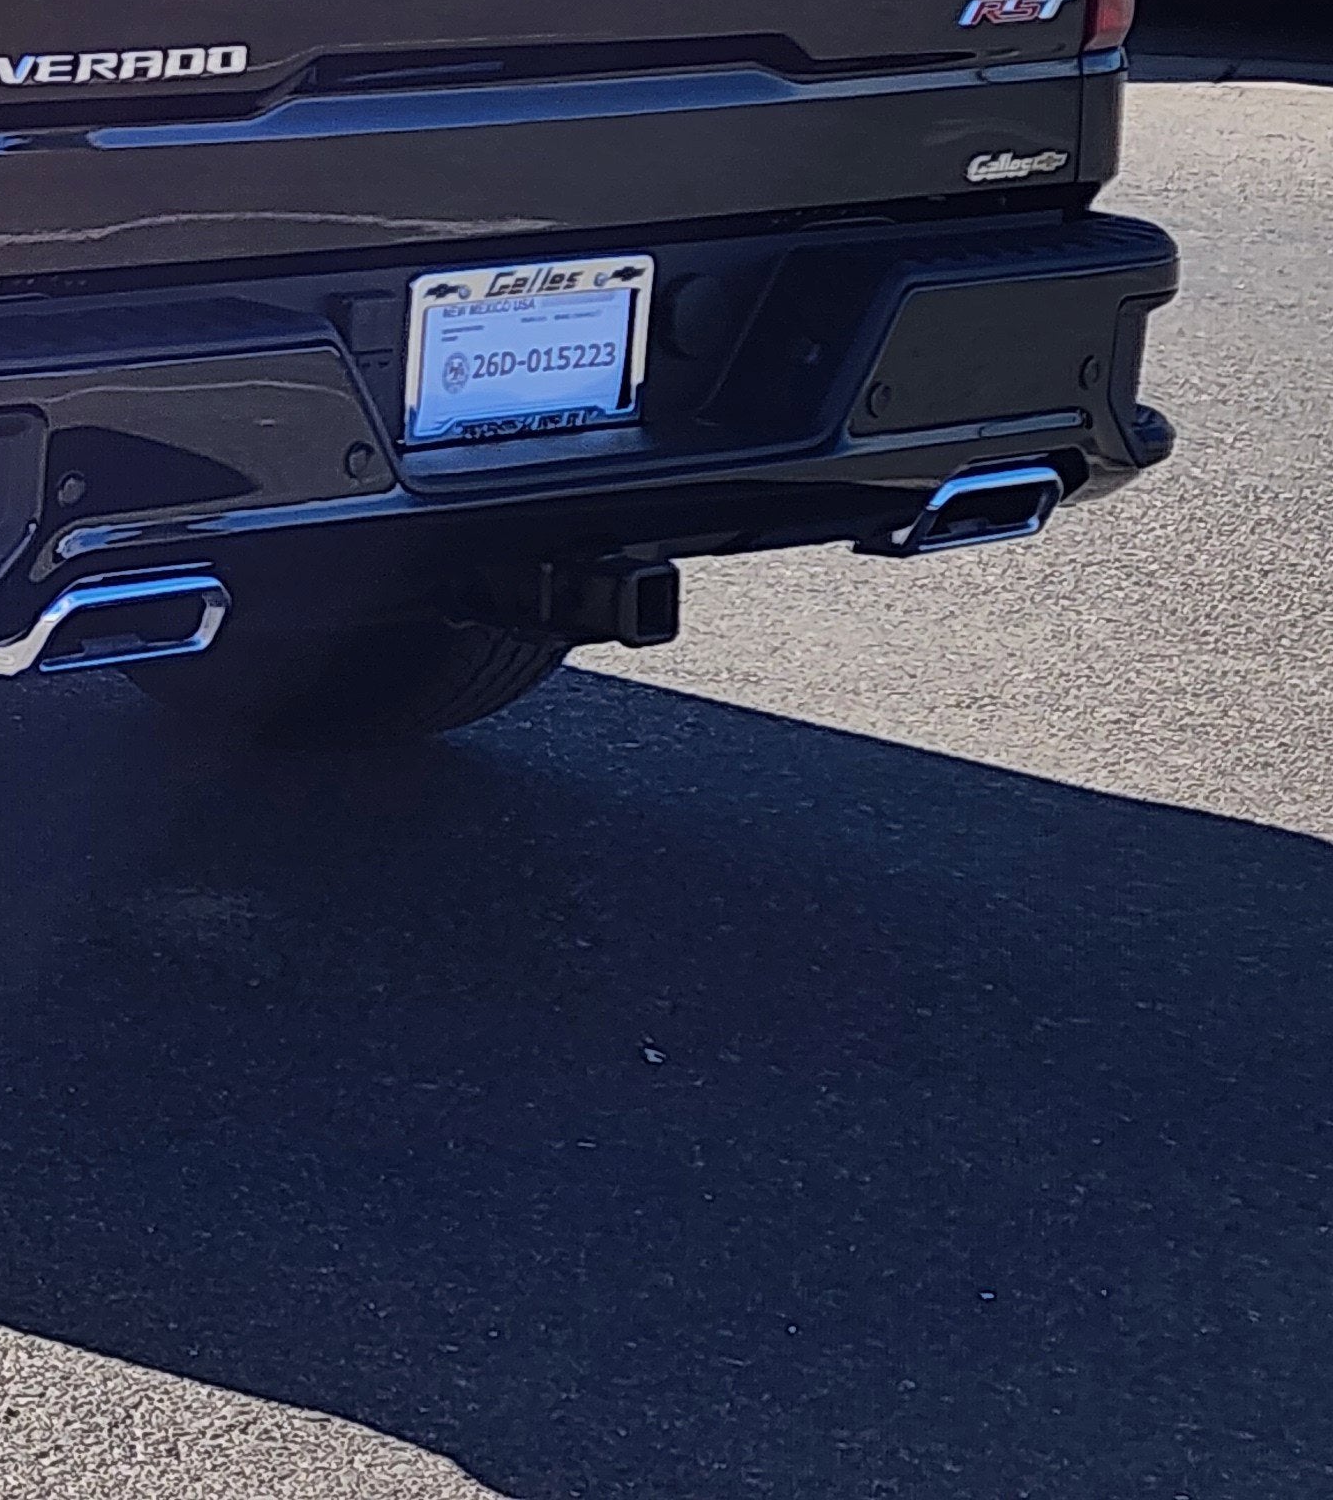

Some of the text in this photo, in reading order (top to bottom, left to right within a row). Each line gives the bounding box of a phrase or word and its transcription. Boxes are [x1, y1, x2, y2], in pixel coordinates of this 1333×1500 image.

[484, 266, 585, 298] Galles
[468, 301, 510, 316] MEXICO
[513, 298, 536, 312] USA
[472, 341, 616, 379] 26D-015223
